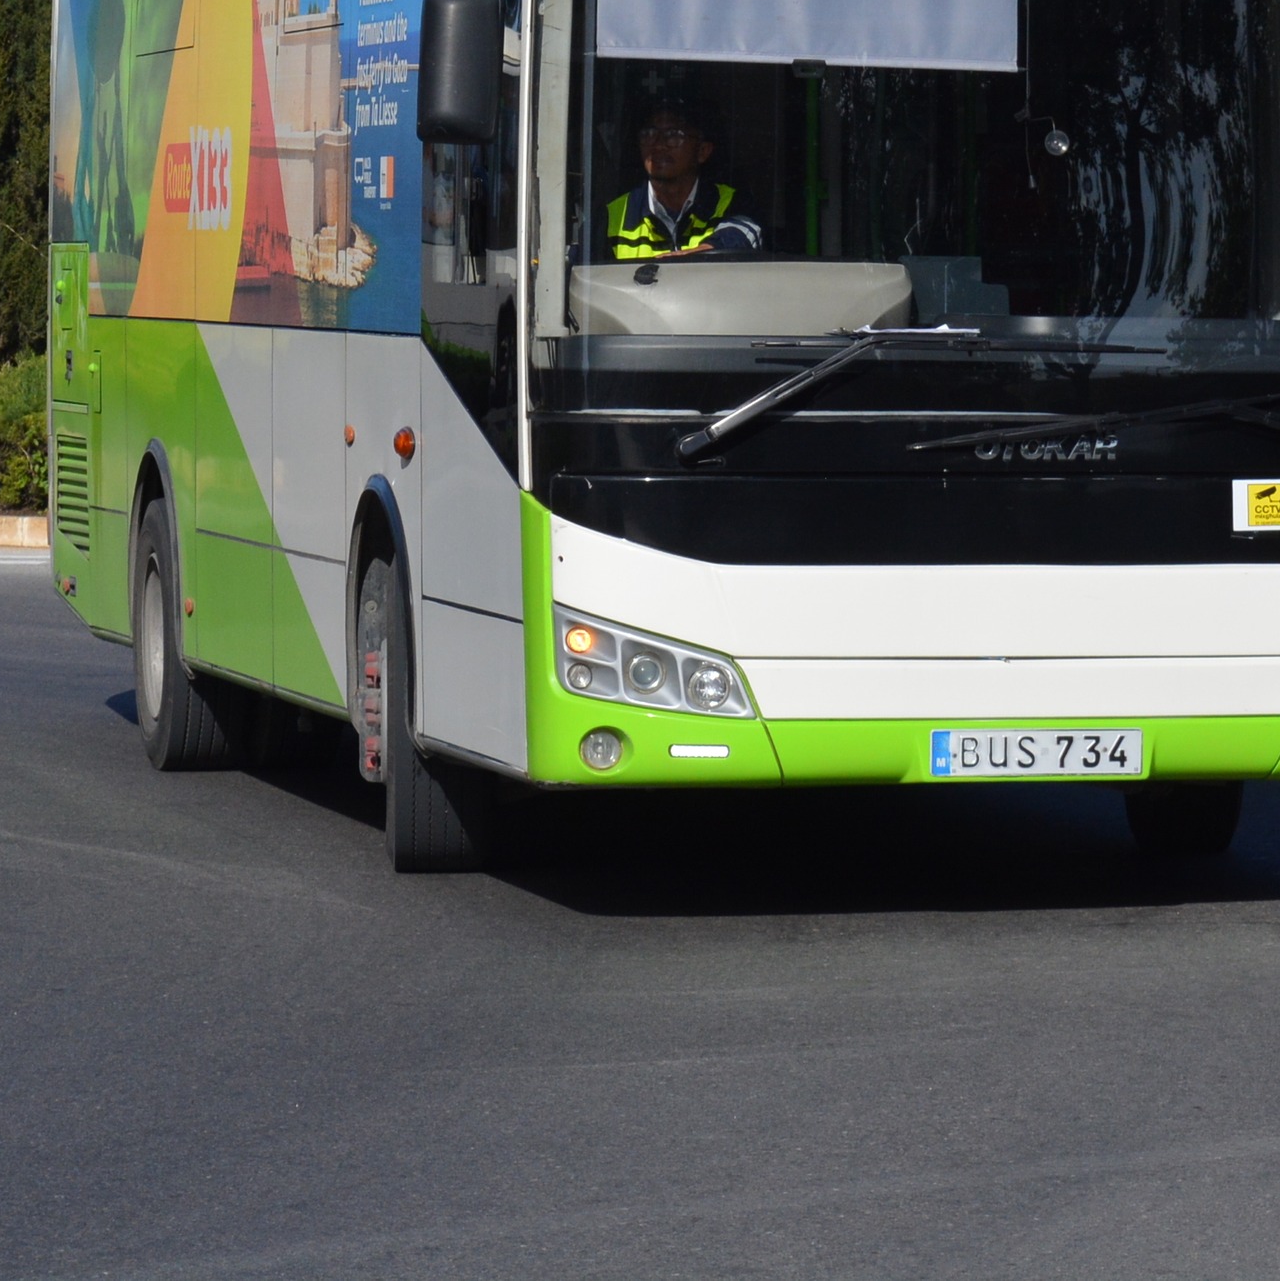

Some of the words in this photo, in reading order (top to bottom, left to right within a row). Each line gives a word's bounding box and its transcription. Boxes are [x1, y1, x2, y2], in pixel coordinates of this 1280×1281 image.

[357, 14, 383, 47] terminus
[384, 11, 396, 43] and
[397, 10, 408, 41] the
[393, 52, 408, 84] Gozo
[355, 97, 371, 136] from
[379, 94, 398, 127] Liesse
[165, 152, 192, 200] Route
[187, 124, 233, 231] X133
[936, 757, 946, 768] M
[960, 735, 1036, 769] BUS
[1055, 735, 1128, 768] 734
